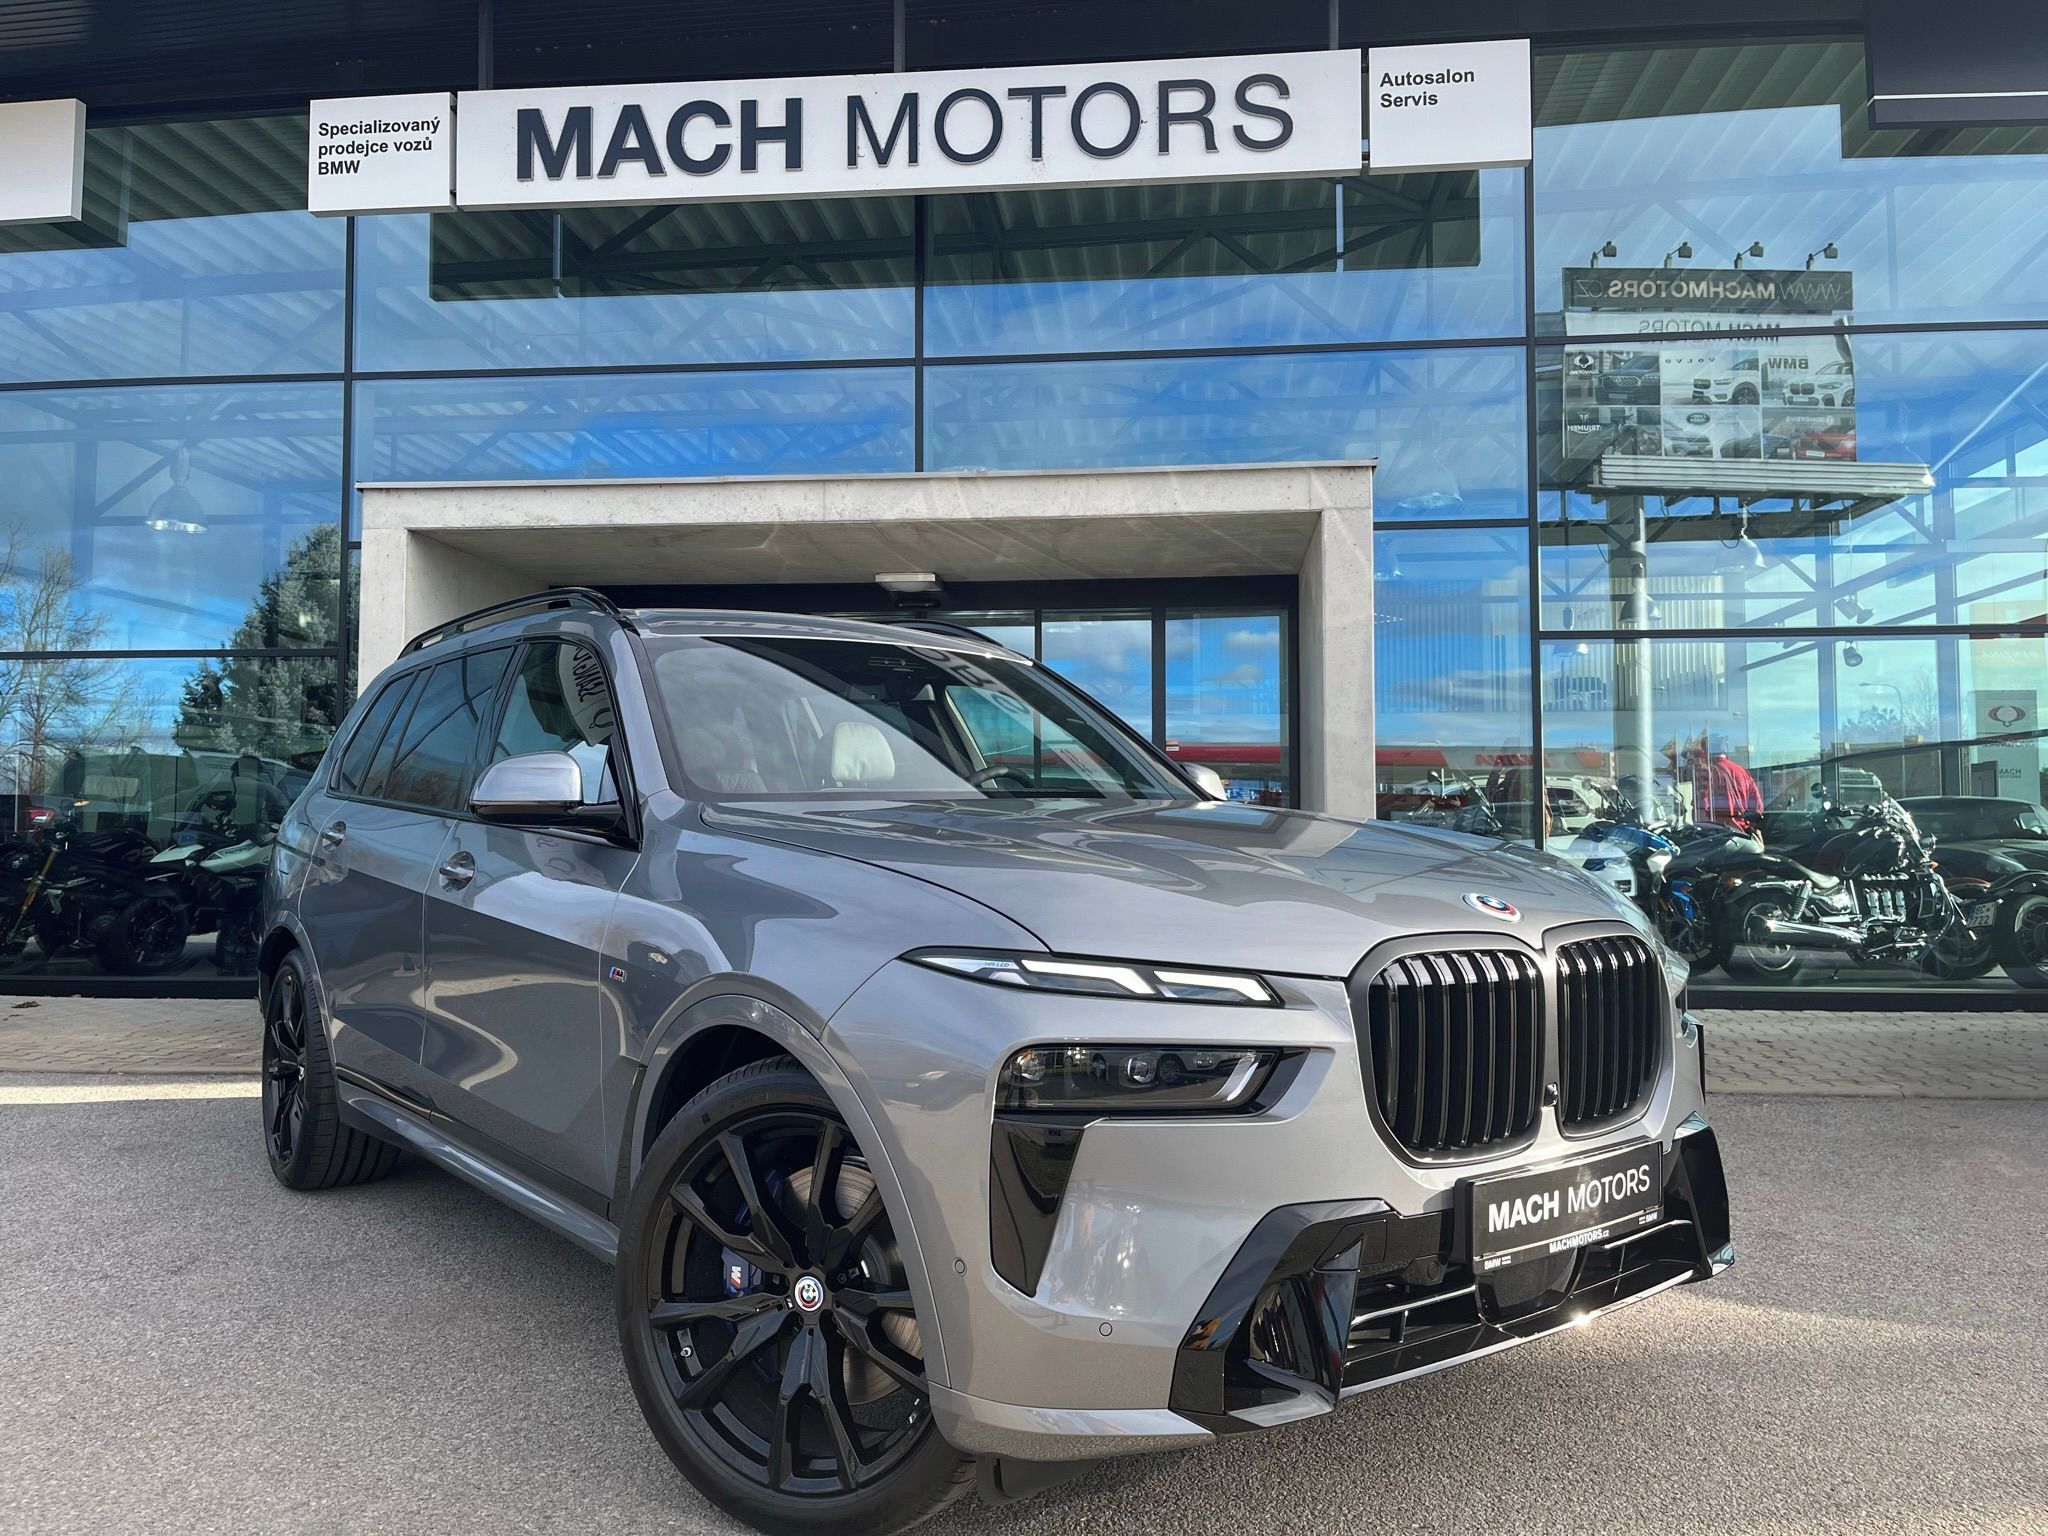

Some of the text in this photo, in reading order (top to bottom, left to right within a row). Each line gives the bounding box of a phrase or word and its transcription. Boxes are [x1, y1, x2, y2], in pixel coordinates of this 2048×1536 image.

[1380, 69, 1475, 87] Autosalon
[1380, 91, 1438, 108] Servis
[318, 116, 441, 139] Specializovaný
[516, 73, 1295, 182] MACH MOTORS
[318, 136, 433, 159] prodejce vozů
[318, 160, 360, 175] BMW
[1488, 1164, 1650, 1233] MACH MOTORS
